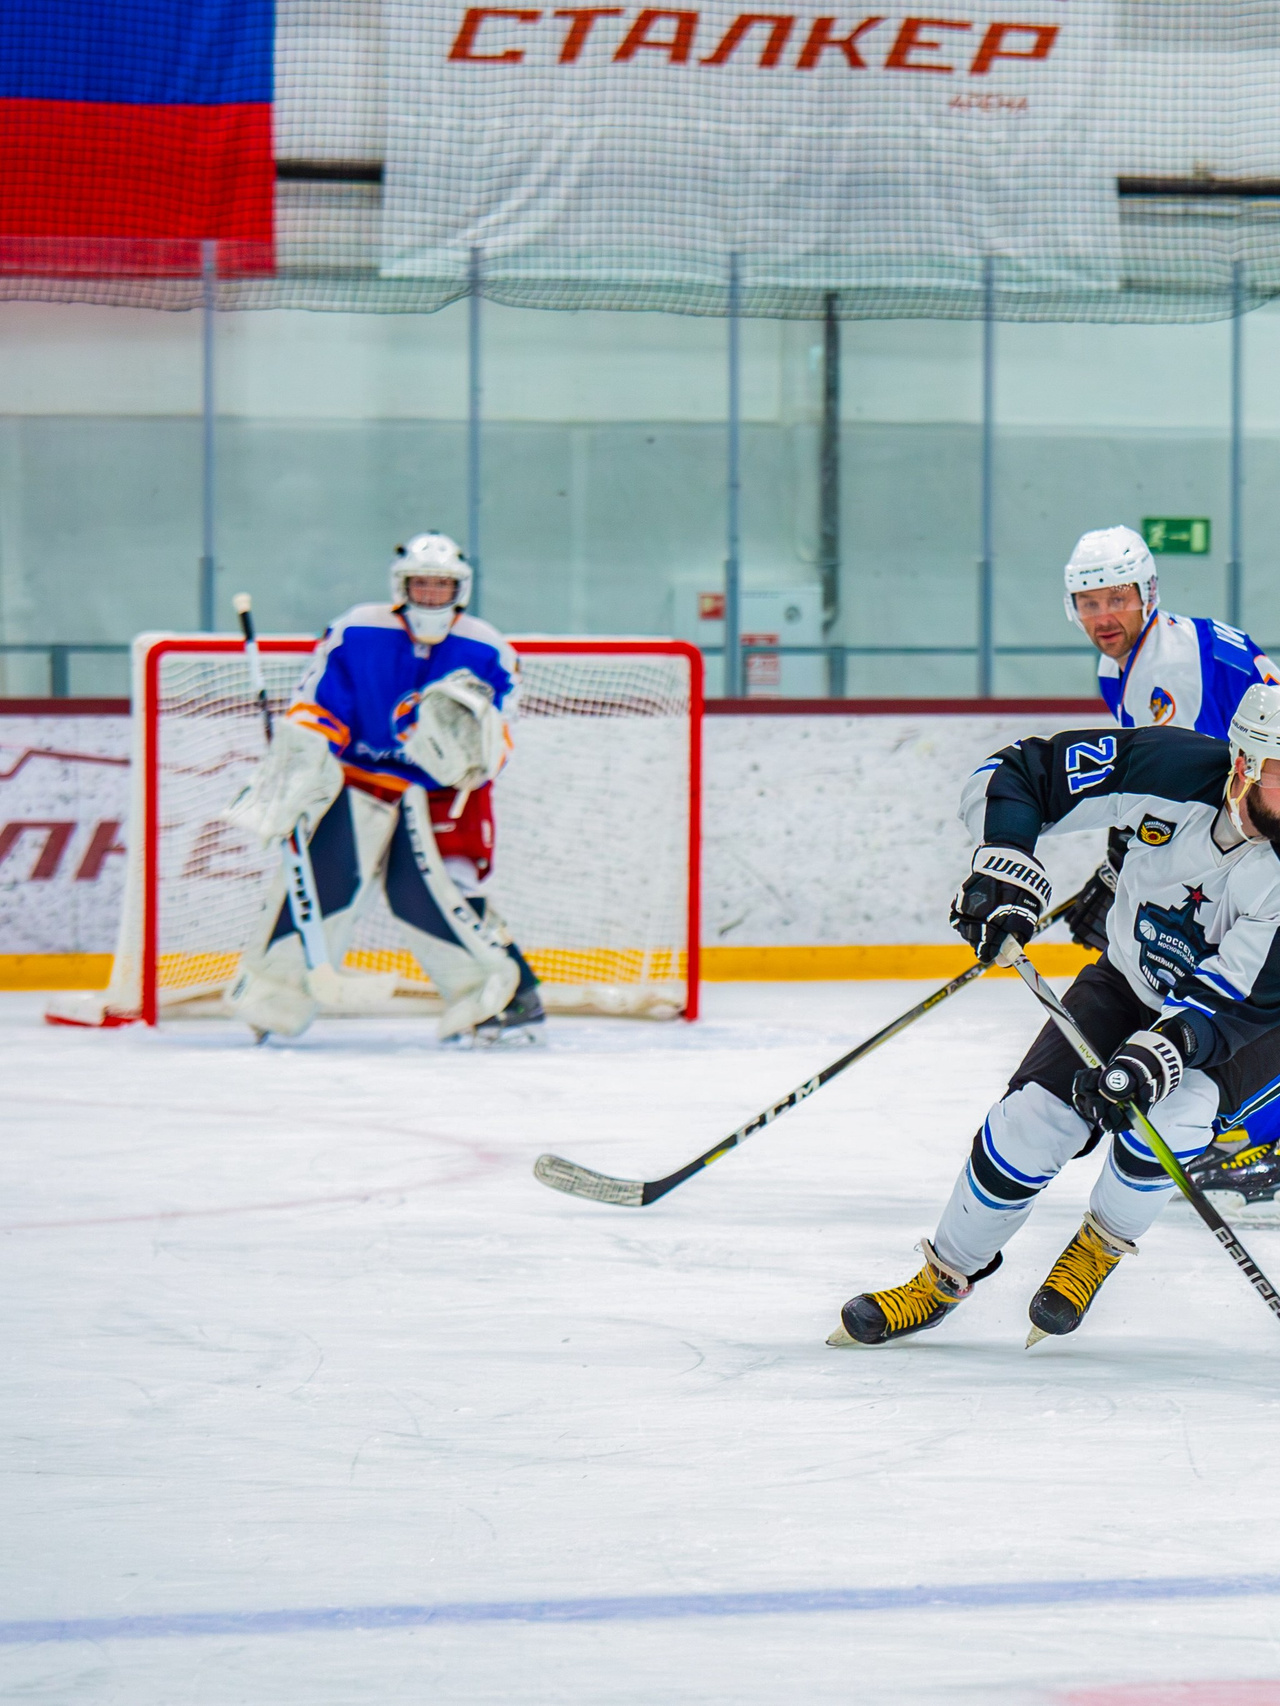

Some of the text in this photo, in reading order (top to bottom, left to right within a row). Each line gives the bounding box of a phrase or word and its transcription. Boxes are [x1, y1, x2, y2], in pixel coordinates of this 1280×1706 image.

[448, 6, 1061, 75] СТАЛКЕР
[1065, 736, 1117, 795] 21
[737, 1076, 820, 1145] CCM
